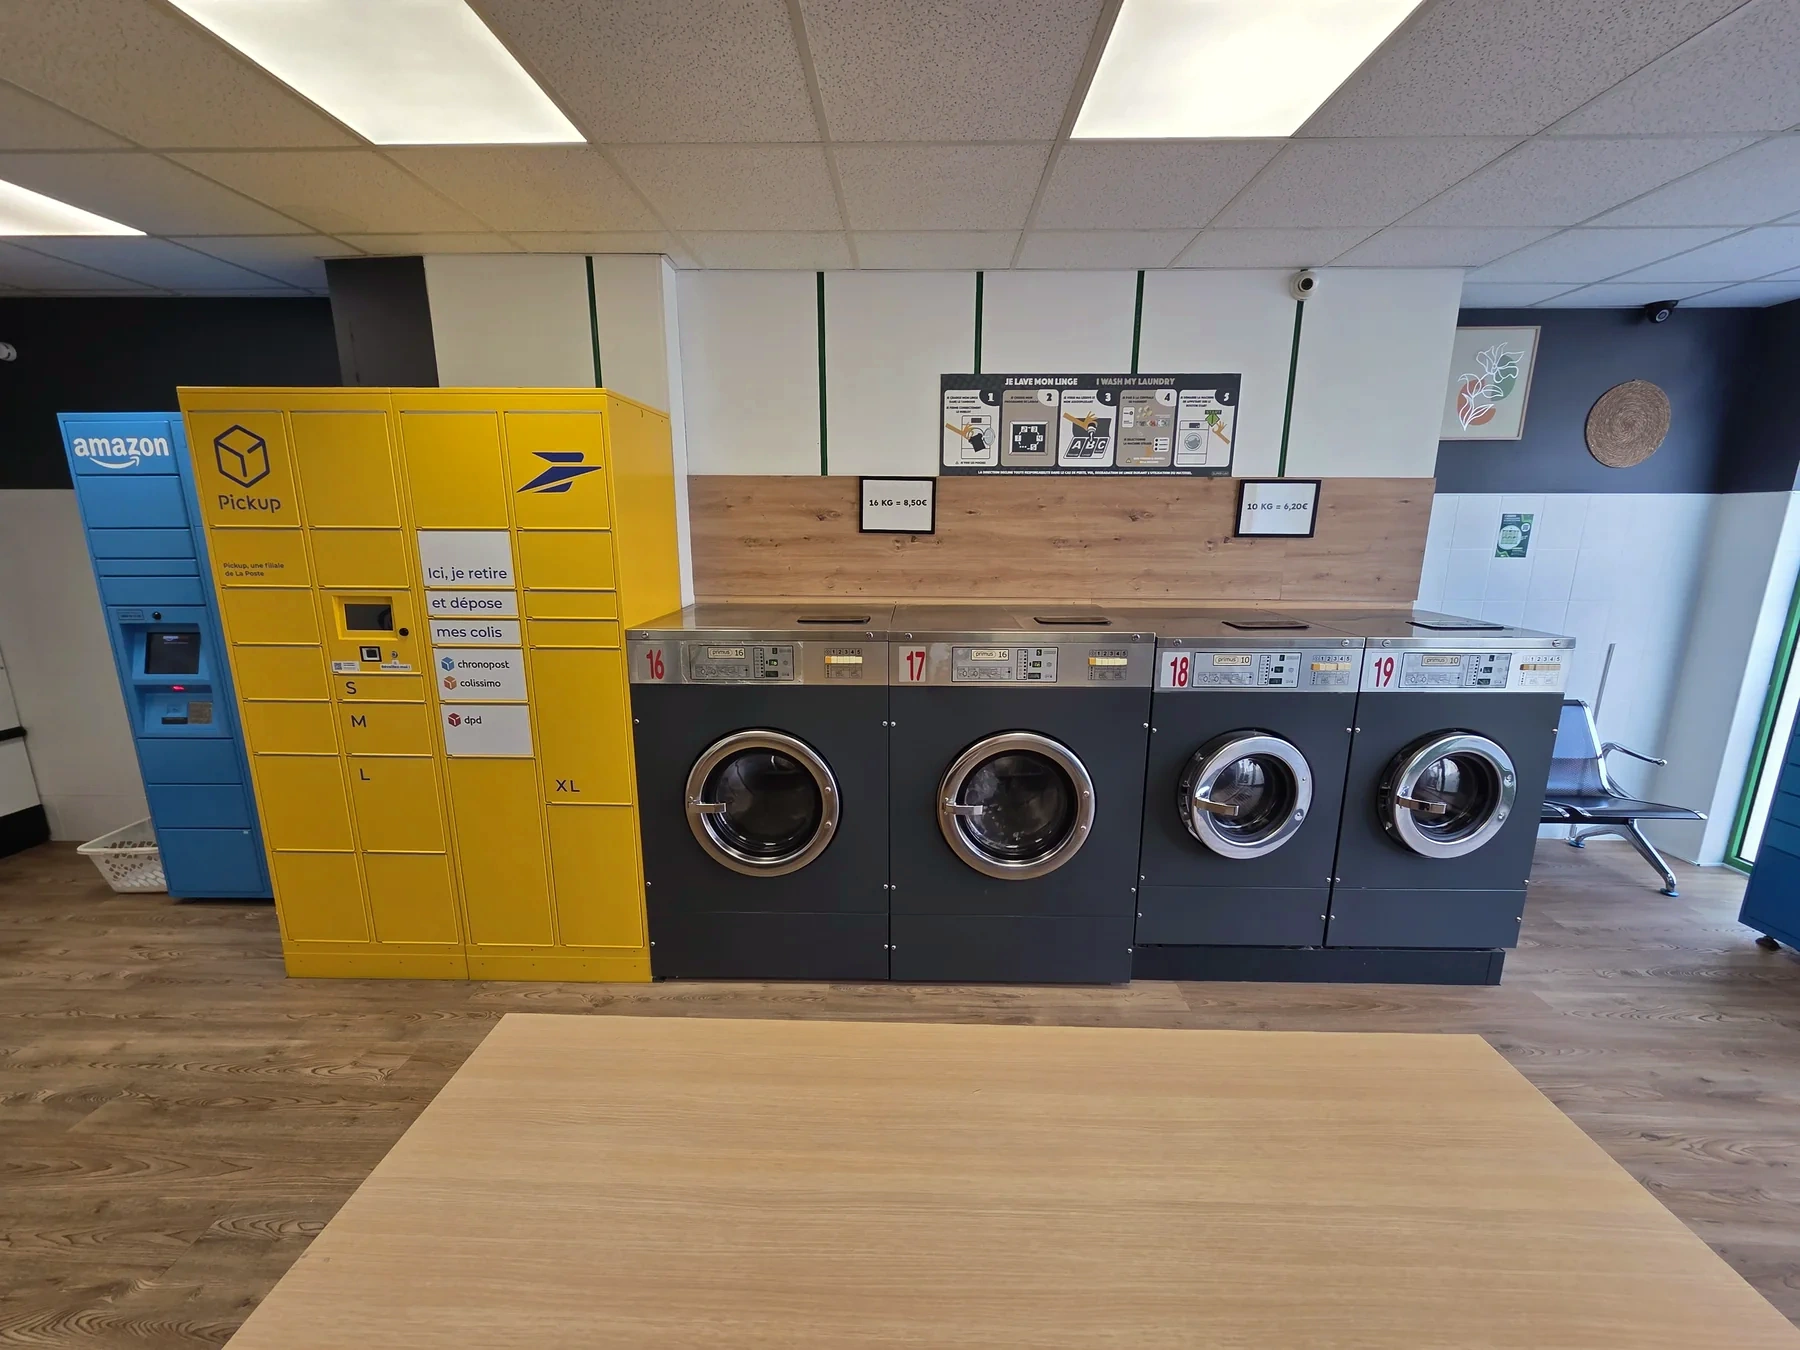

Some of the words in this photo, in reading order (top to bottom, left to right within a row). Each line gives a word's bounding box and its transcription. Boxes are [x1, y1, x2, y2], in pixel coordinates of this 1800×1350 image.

[1005, 378, 1013, 386] JE
[1014, 378, 1033, 386] LAVE
[1034, 378, 1054, 386] MON
[1055, 378, 1078, 386] LINGE
[1096, 378, 1099, 386] I
[1100, 378, 1123, 386] WASH
[1124, 378, 1138, 386] MY
[1138, 378, 1175, 386] LAUNDRY
[988, 392, 994, 402] 1
[1046, 393, 1052, 402] 2
[1104, 392, 1112, 402] 3
[1164, 392, 1170, 402] 4
[1224, 392, 1230, 402] 5
[73, 437, 170, 458] amazon
[1072, 440, 1080, 450] A
[1086, 440, 1096, 450] B
[1098, 440, 1106, 450] C
[218, 494, 281, 514] Pickup
[1284, 503, 1308, 511] 6,20€
[428, 567, 448, 580] Ici,
[451, 567, 464, 581] je
[468, 567, 507, 579] retire
[432, 598, 447, 609] et
[450, 597, 503, 611] dépose
[436, 628, 467, 638] mes
[470, 626, 503, 638] colis
[458, 660, 510, 670] chronopost
[646, 649, 664, 680] 16
[906, 651, 925, 681] 17
[1170, 656, 1188, 686] 18
[1375, 657, 1394, 687] 19
[345, 681, 357, 694] S
[460, 679, 501, 687] colissimo
[350, 715, 367, 728] M
[464, 716, 482, 725] dpd
[360, 768, 371, 781] L
[556, 779, 580, 792] XL
